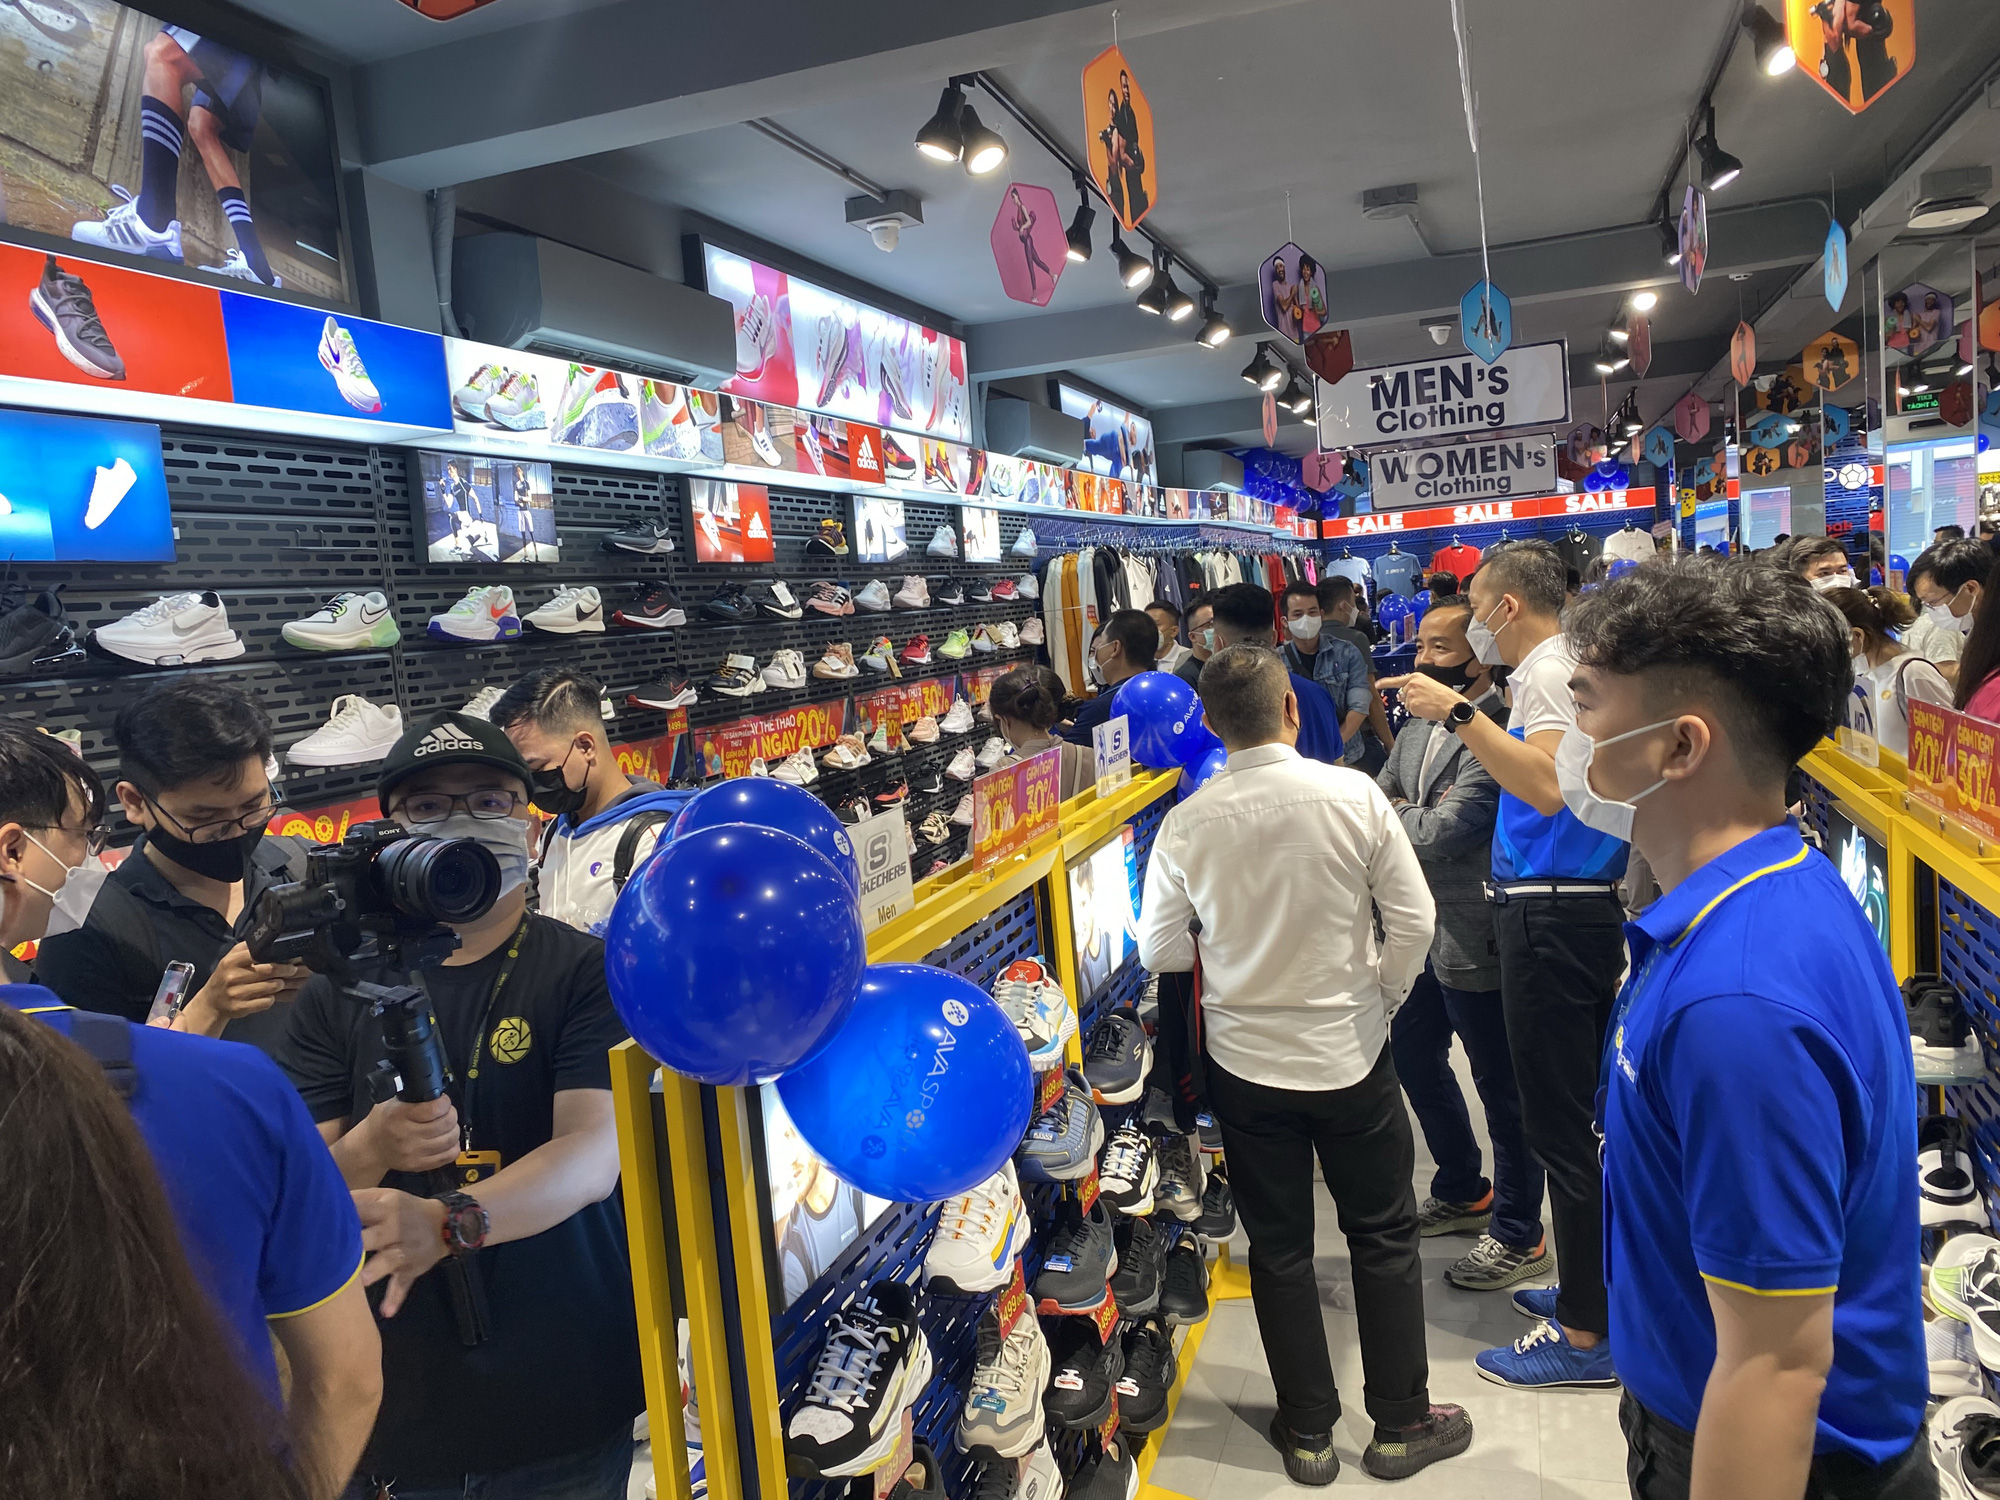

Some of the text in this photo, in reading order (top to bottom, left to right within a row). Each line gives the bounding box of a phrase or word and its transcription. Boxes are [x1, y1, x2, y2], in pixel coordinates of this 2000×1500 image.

[1370, 362, 1509, 411] MEN's
[1376, 400, 1506, 434] Clothing
[1380, 441, 1547, 484] WOMEN's
[1414, 474, 1512, 498] Clothing
[1566, 491, 1627, 513] SALE
[1346, 514, 1404, 534] SALE
[1454, 502, 1513, 523] SALE
[902, 701, 920, 721] ĐẾN
[922, 684, 949, 716] 30%
[761, 729, 797, 758] NGAY
[796, 706, 836, 748] 20%
[775, 714, 795, 730] THAO
[414, 739, 484, 757] adidas
[1915, 730, 1946, 786] 20%
[724, 758, 751, 779] 30%
[1957, 749, 1996, 812] 30%
[1026, 774, 1054, 828] 30%
[378, 827, 400, 836] SONY
[982, 795, 1015, 852] 20%
[860, 862, 907, 897] SKECHERS
[877, 904, 897, 925] Men
